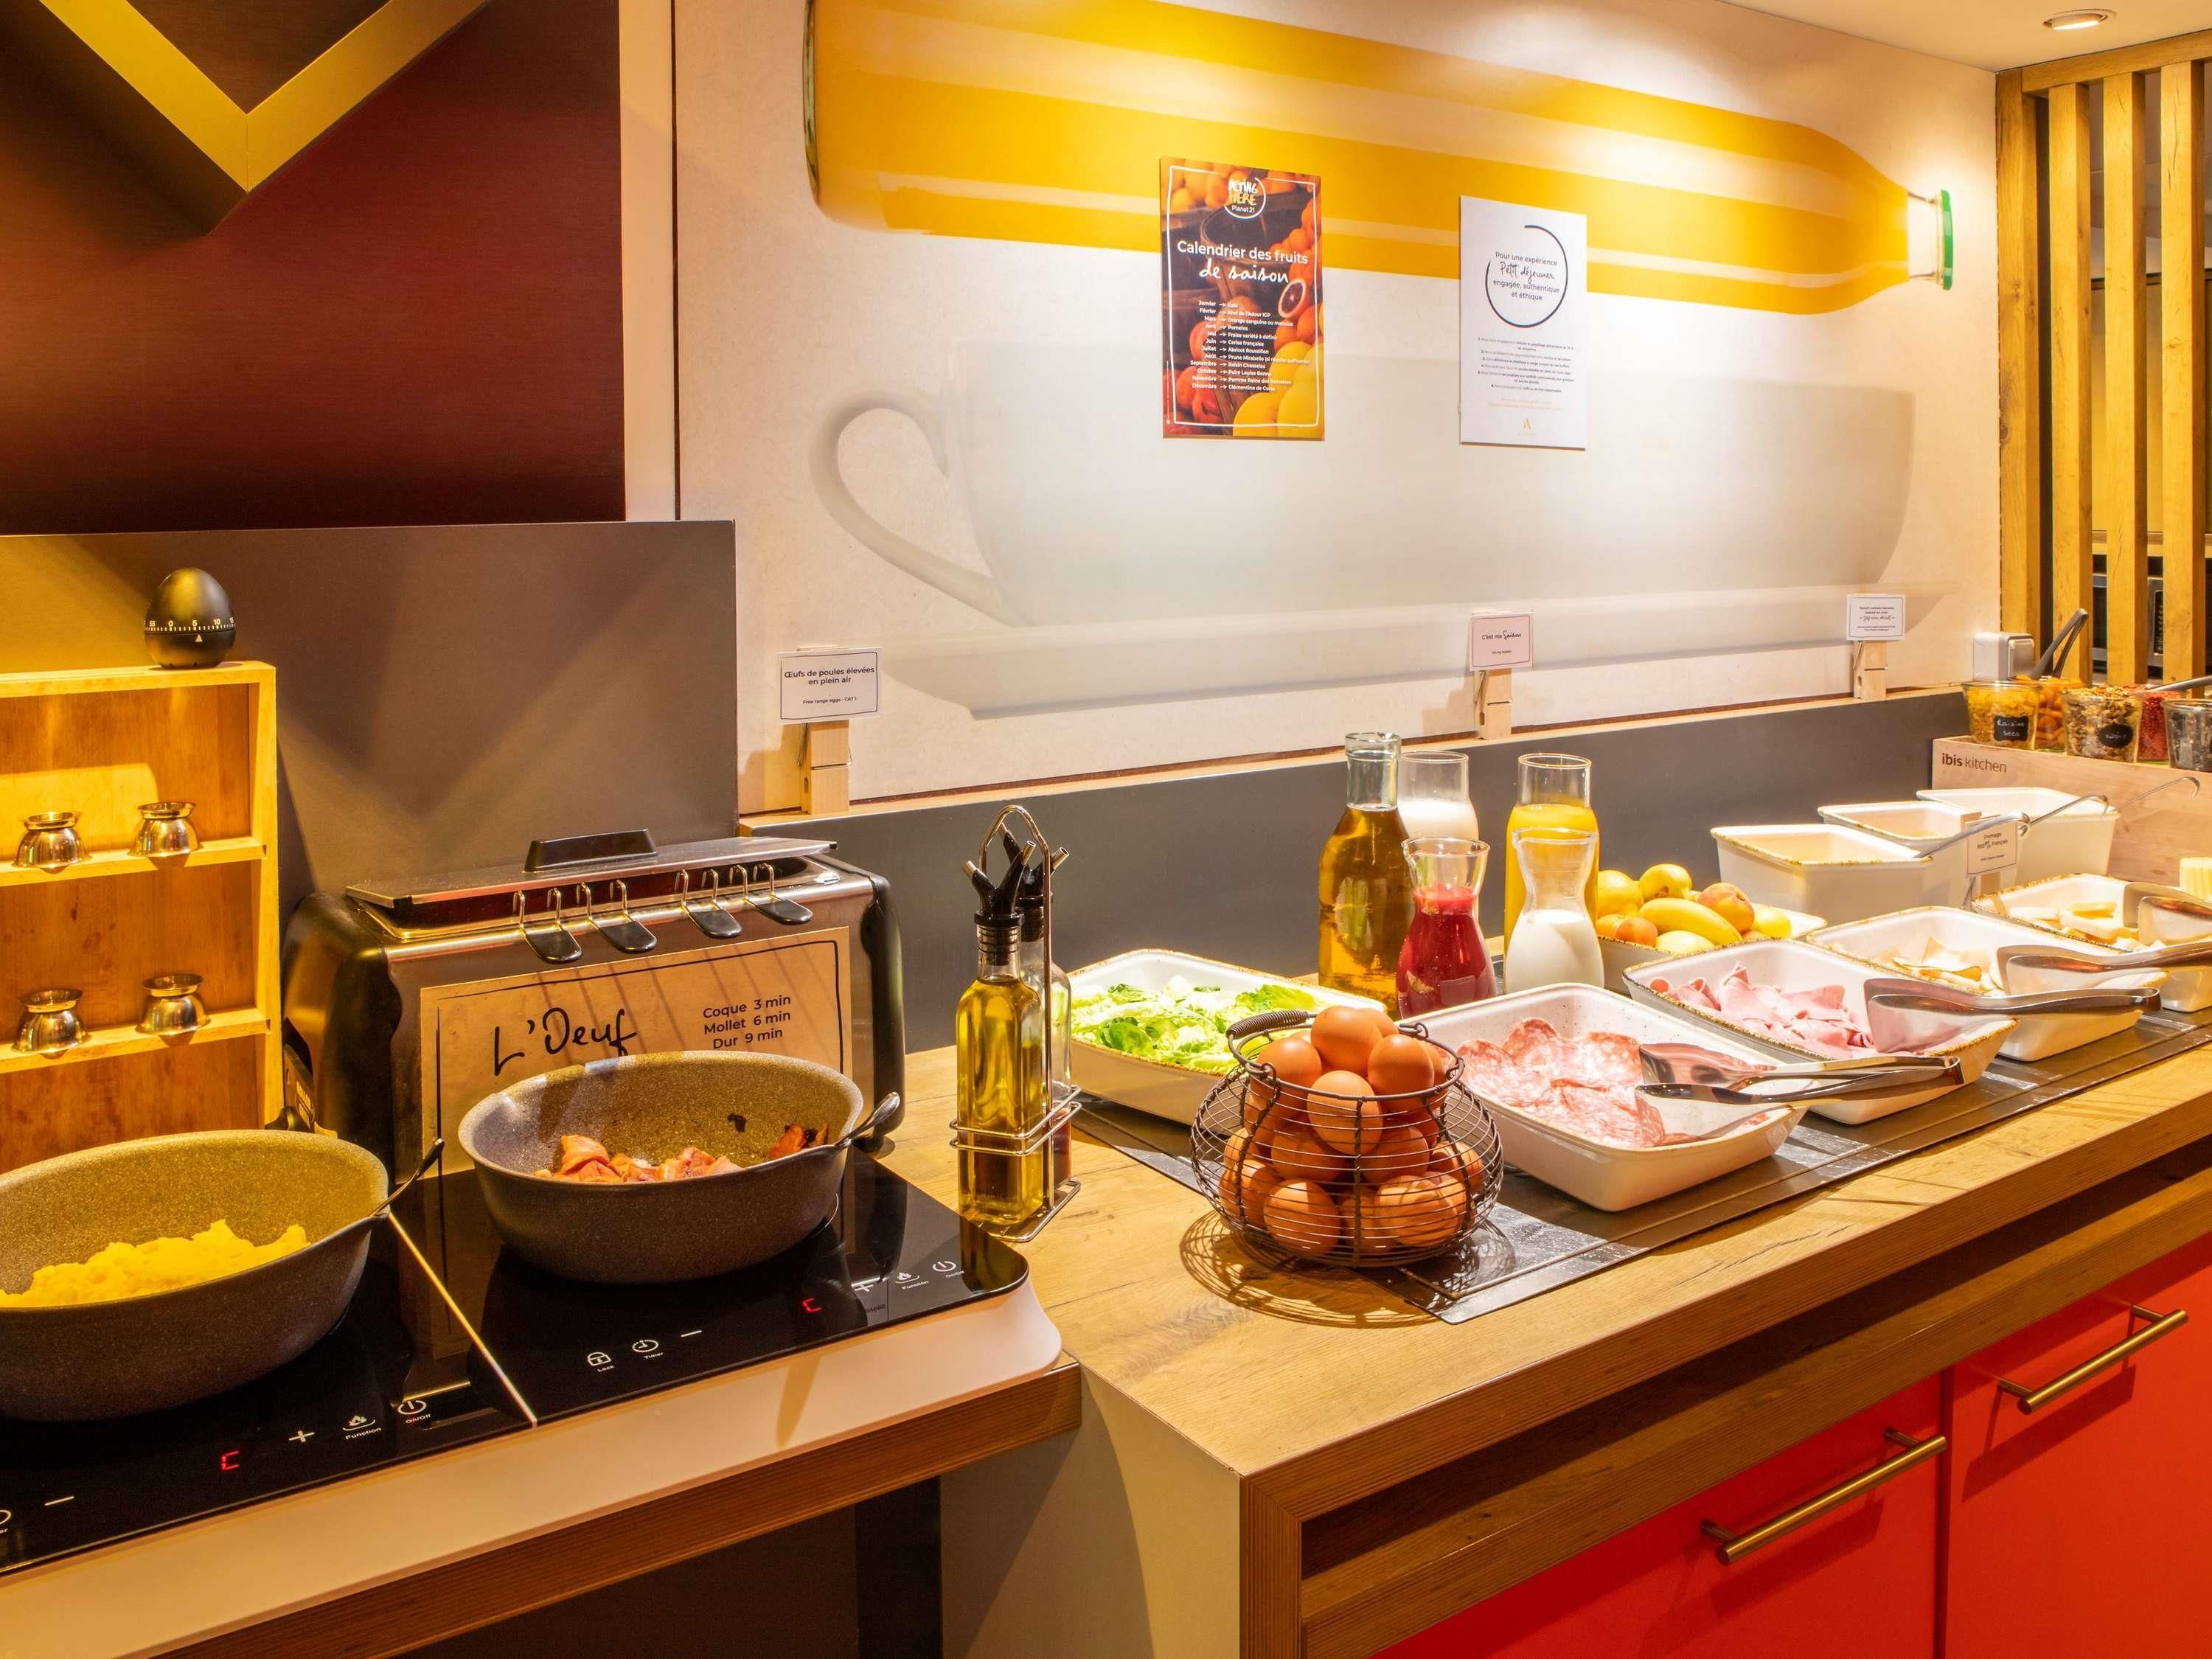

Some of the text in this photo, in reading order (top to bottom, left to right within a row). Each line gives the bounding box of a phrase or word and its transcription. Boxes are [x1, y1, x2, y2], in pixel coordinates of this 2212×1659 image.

[1232, 204, 1248, 213] Planet
[1178, 240, 1308, 265] Calendrier des fruits
[1495, 251, 1510, 260] Pour
[1525, 256, 1557, 266] expérience
[1199, 258, 1288, 283] de saison
[1500, 261, 1554, 284] Petit déjeuner
[1493, 279, 1559, 293] engagée, authentique
[1519, 292, 1543, 300] éthique
[1503, 630, 1521, 640] Saison
[785, 670, 805, 678] Œufs
[819, 668, 844, 677] poules
[821, 677, 839, 685] plein
[1942, 753, 2006, 773] ibis kitchen
[703, 995, 790, 1018] Coque 3 min
[704, 1011, 790, 1034] Mollet 6 min
[713, 1028, 782, 1049] Dur 9 min
[901, 1280, 929, 1290] Function
[406, 1414, 431, 1424] On/Off
[345, 1427, 381, 1440] Function
